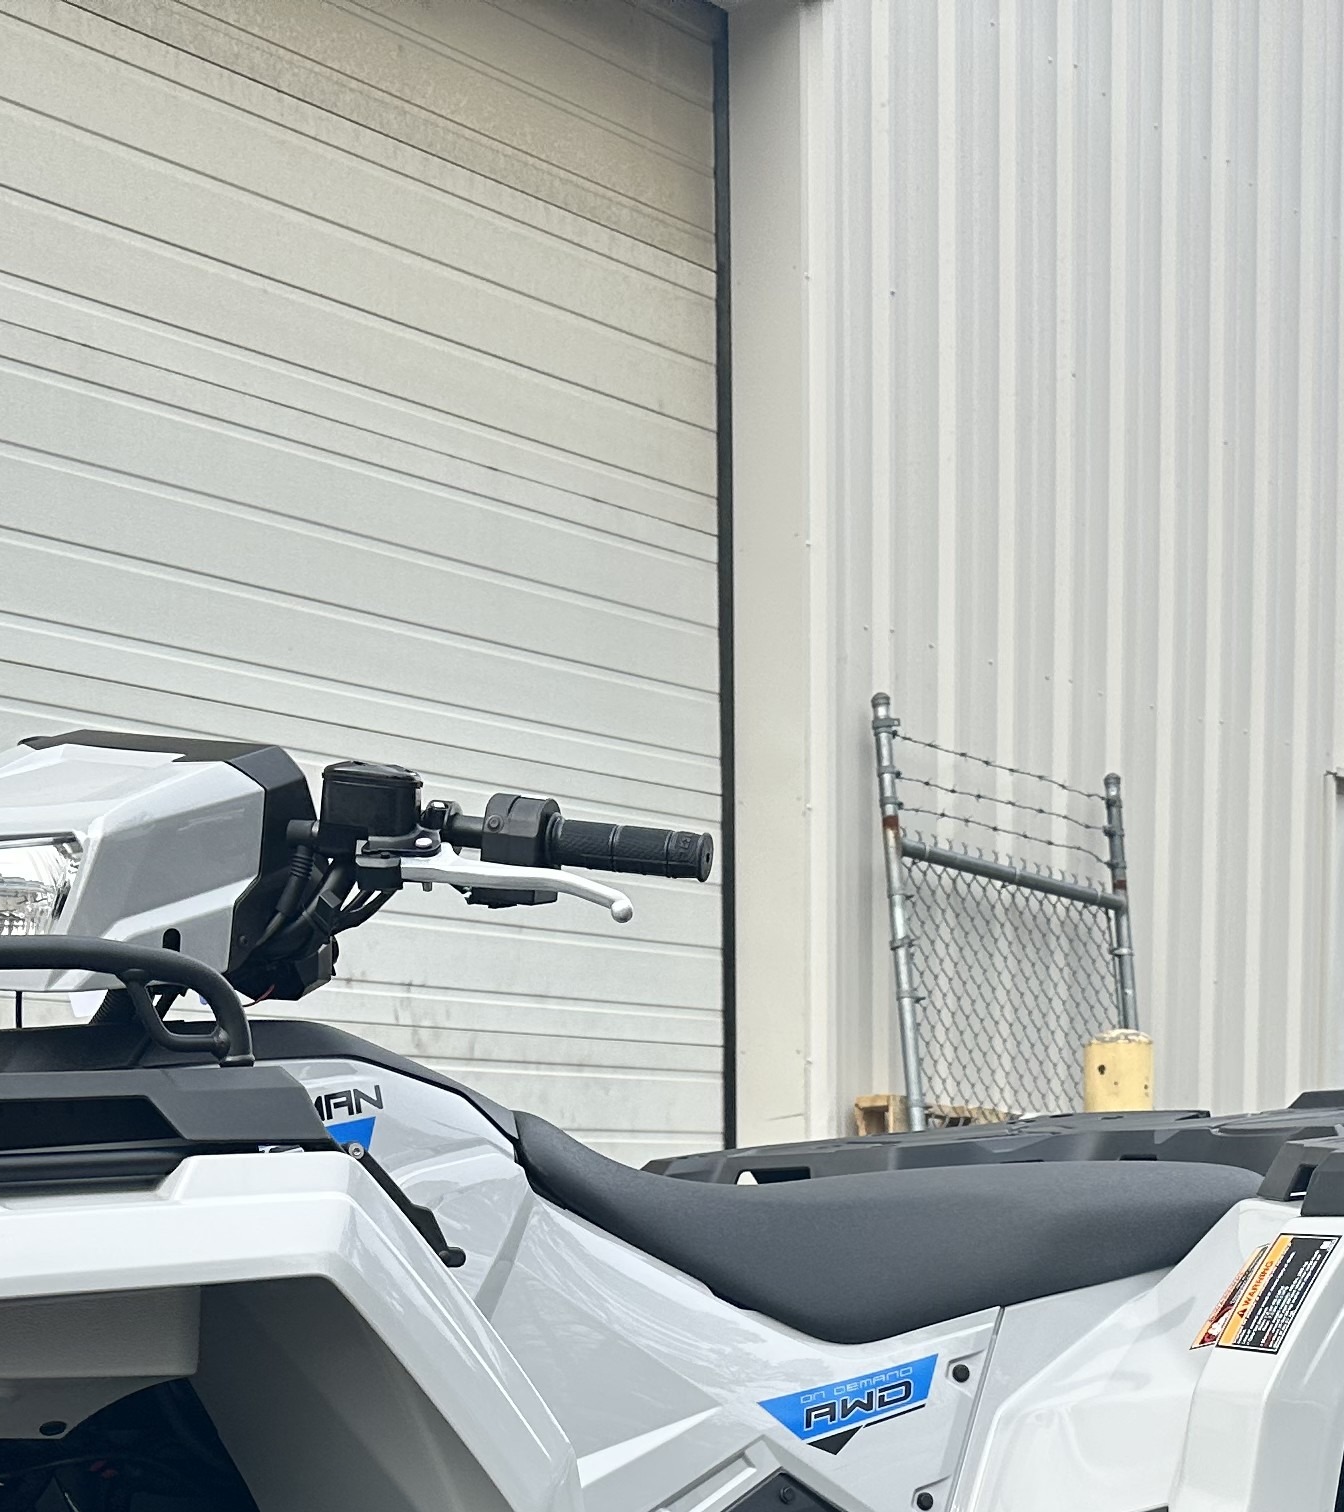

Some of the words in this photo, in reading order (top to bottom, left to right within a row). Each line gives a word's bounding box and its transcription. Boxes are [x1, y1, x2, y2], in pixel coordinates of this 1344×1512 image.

[1242, 1259, 1275, 1306] WARNING
[800, 1390, 826, 1405] ON
[833, 1366, 913, 1396] DEMAND
[803, 1378, 913, 1432] AWD
